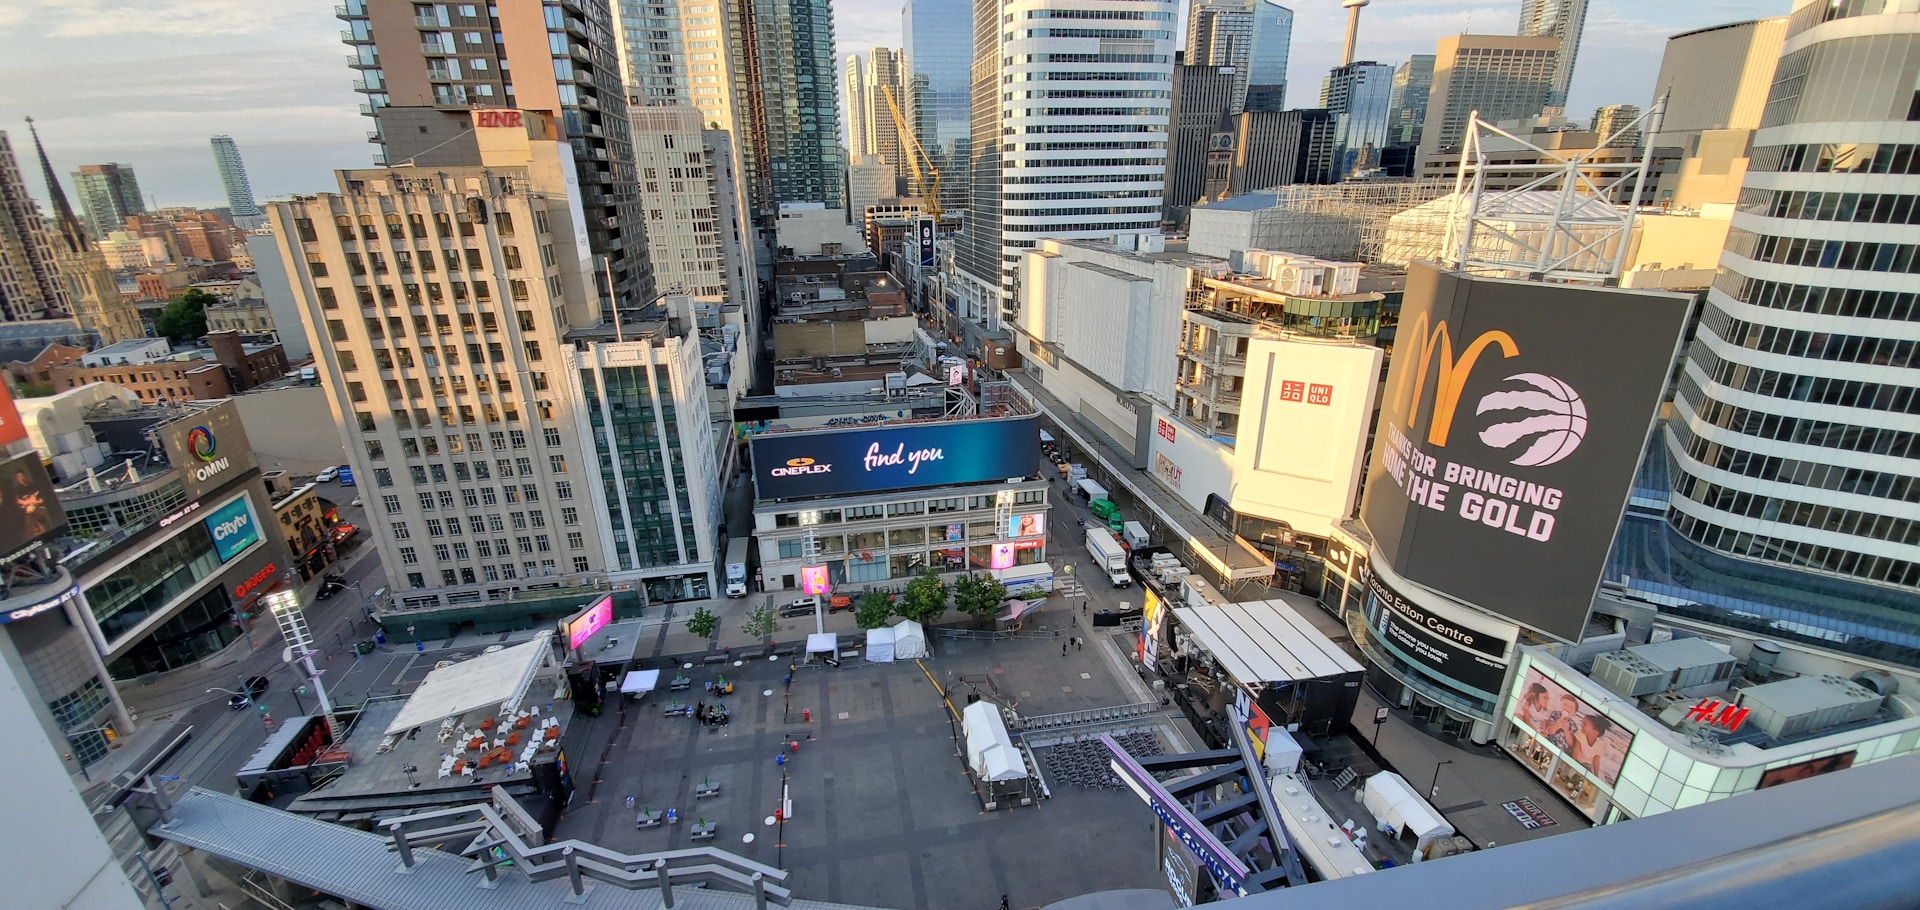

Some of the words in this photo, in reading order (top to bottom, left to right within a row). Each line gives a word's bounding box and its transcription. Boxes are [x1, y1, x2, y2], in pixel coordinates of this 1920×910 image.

[477, 111, 523, 128] HNR
[196, 457, 230, 481] OMNI
[771, 464, 833, 477] CINEPLEX
[863, 442, 905, 471] find
[908, 448, 944, 474] you
[1388, 422, 1411, 461] THANKS
[1411, 448, 1437, 477] FOR
[1444, 462, 1563, 511] BRINGING
[1382, 443, 1407, 487] HOME
[1406, 471, 1450, 512] THE
[1459, 492, 1556, 542] GOLD
[214, 514, 248, 540] Citytv
[0, 541, 43, 566] Panasonic
[244, 562, 276, 591] ROGERS
[1369, 573, 1393, 603] Toronto
[1394, 597, 1424, 623] Eaton
[1427, 617, 1474, 645] Centre
[1389, 627, 1398, 637] The
[1397, 634, 1416, 648] colour
[1415, 645, 1427, 656] you
[1390, 621, 1400, 631] The
[1399, 628, 1417, 642] phone
[1416, 640, 1429, 650] you
[1429, 646, 1449, 660] want.
[1502, 801, 1541, 829] SIDE
[1517, 799, 1556, 825] NORTH
